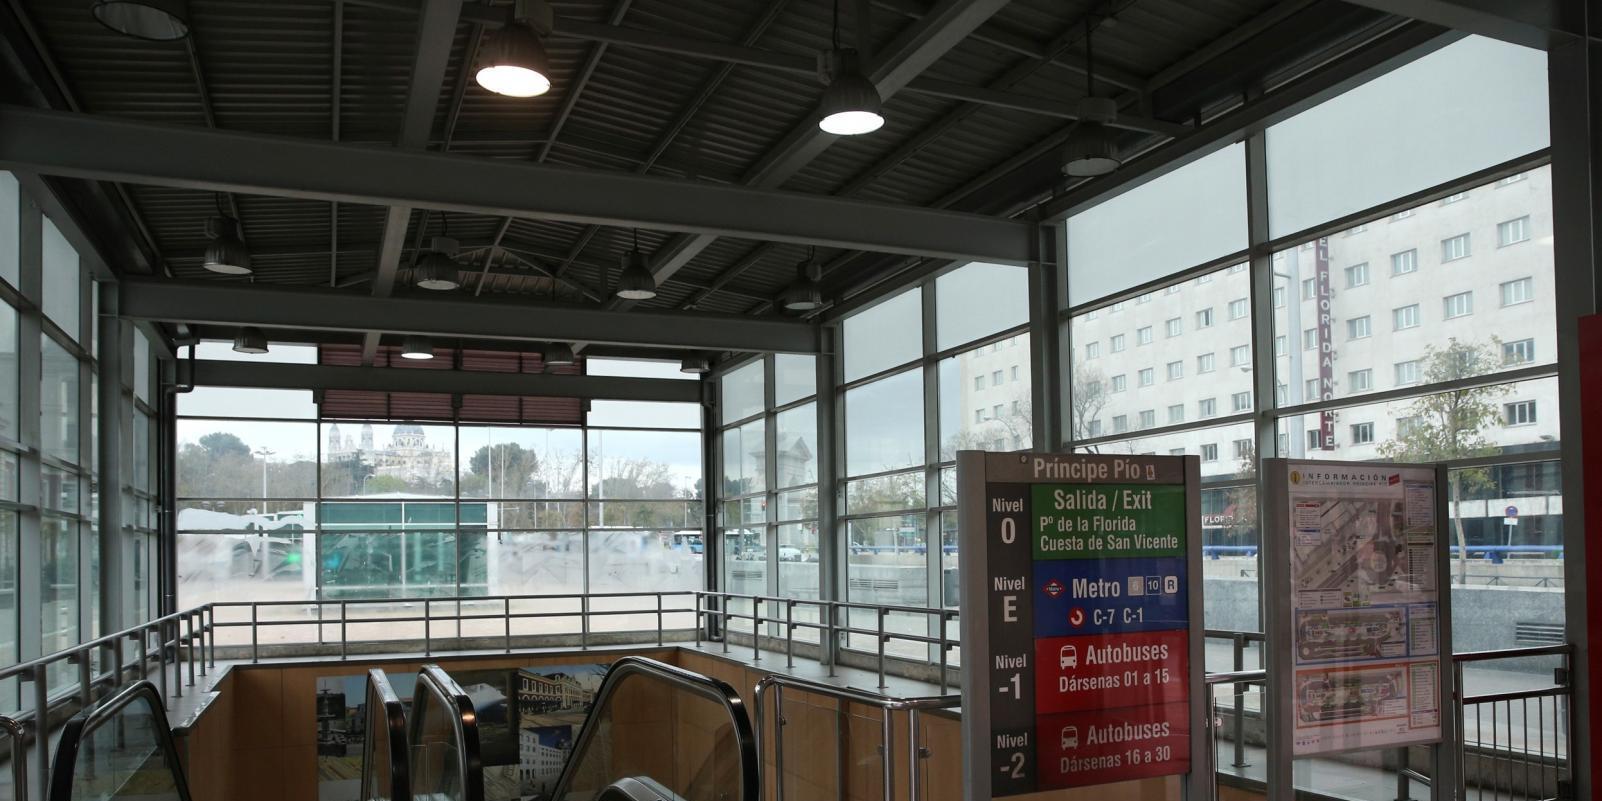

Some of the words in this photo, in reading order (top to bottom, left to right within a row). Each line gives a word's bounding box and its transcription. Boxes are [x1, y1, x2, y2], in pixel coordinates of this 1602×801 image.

[1320, 271, 1332, 368] FLORIDA
[1323, 378, 1334, 447] NORTE
[1034, 458, 1108, 482] Príncipe
[1114, 459, 1140, 479] Pío
[1302, 472, 1386, 481] INFORMACIÓN
[993, 498, 1023, 512] Nivel
[1054, 489, 1107, 510] Salida
[1112, 490, 1118, 511] /
[1123, 490, 1152, 509] Exit
[1001, 517, 1016, 544] 0
[1057, 517, 1073, 531] de
[1078, 517, 1088, 531] la
[1093, 516, 1136, 531] Florida
[1040, 535, 1084, 551] Cuesta
[1088, 535, 1103, 550] de
[1107, 535, 1130, 550] San
[1134, 534, 1178, 549] Vicente
[994, 577, 1025, 591] Nivel
[1072, 578, 1120, 599] Metro
[1147, 580, 1159, 590] 10
[1003, 596, 1017, 622] E
[1093, 608, 1115, 625] C-7
[1123, 607, 1143, 623] C-1
[995, 654, 1027, 670] Nivel
[1085, 643, 1169, 666] Autobuses
[998, 673, 1021, 699] -1
[1059, 674, 1120, 693] Dársenas
[1124, 671, 1138, 687] 01
[1143, 673, 1150, 685] a
[1155, 668, 1169, 684] 15
[997, 732, 1028, 749] Nivel
[1087, 721, 1170, 745] Autobuses
[1000, 752, 1025, 780] -2
[1060, 754, 1121, 774] Dársenas
[1125, 749, 1139, 765] 16
[1144, 751, 1152, 763] a
[1155, 746, 1171, 762] 30
